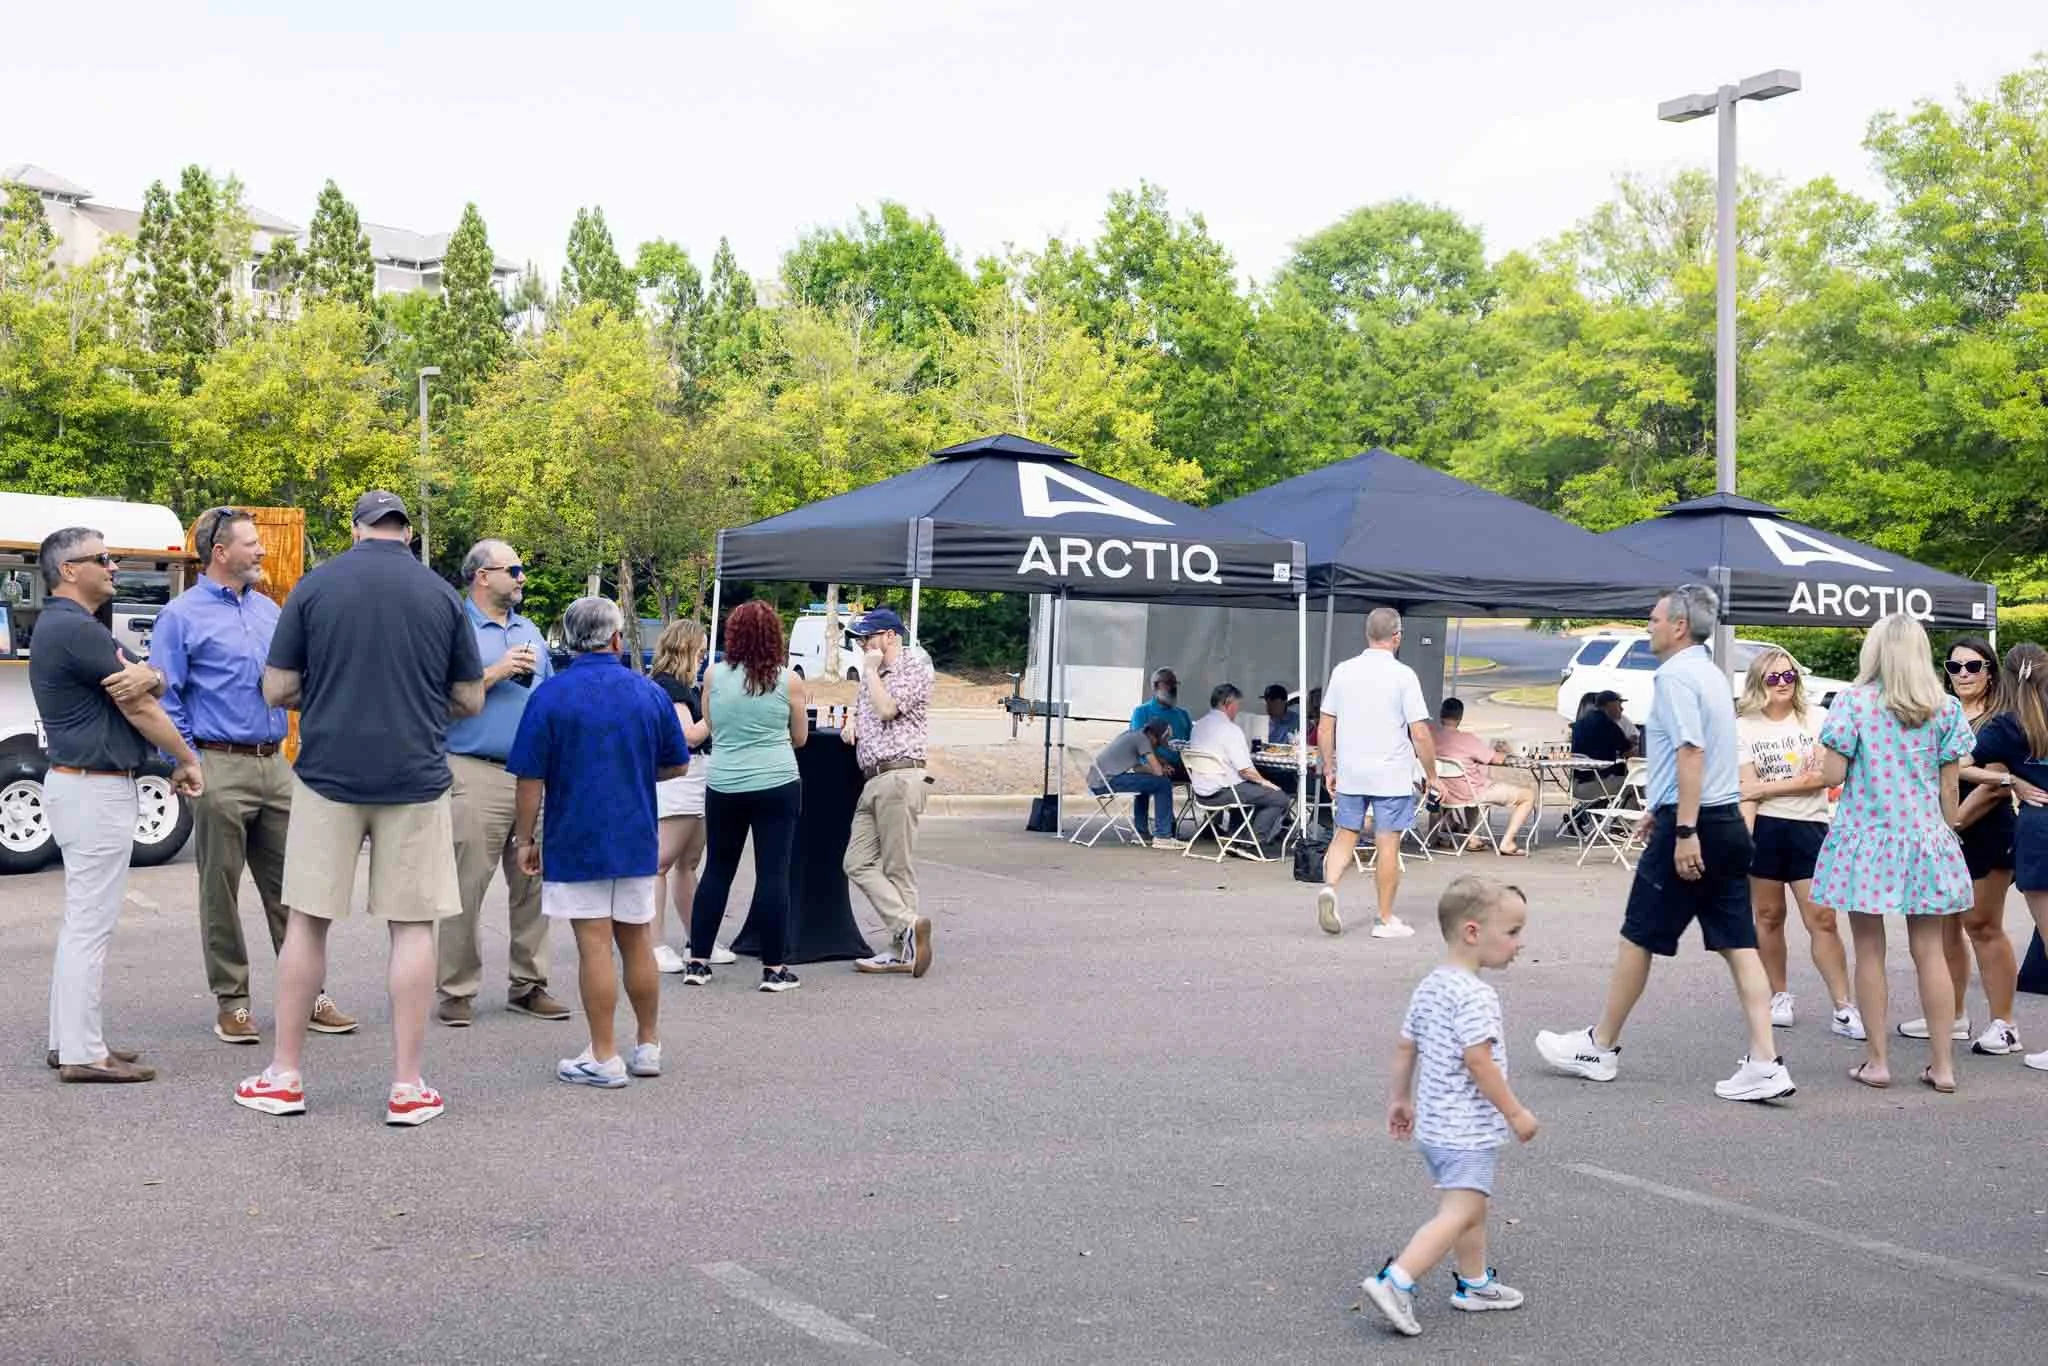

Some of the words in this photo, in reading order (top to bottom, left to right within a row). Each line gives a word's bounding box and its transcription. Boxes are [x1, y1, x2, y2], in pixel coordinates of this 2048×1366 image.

[1017, 536, 1222, 585] ARCTIQ
[1788, 581, 1936, 623] ARCTIQ
[1575, 1053, 1600, 1063] HOKA
